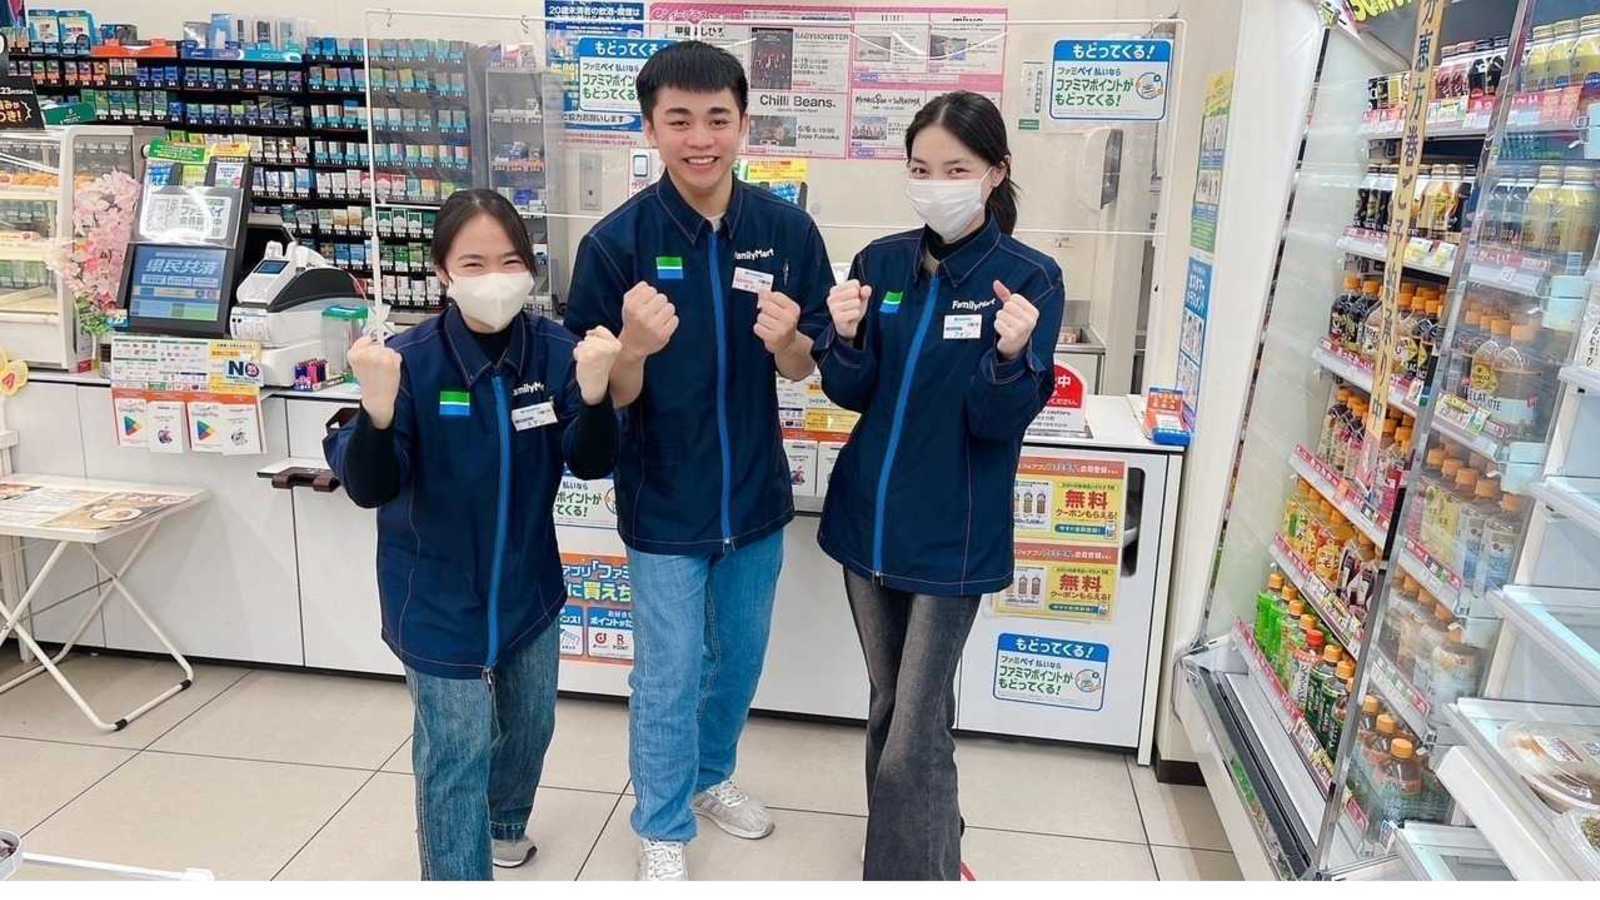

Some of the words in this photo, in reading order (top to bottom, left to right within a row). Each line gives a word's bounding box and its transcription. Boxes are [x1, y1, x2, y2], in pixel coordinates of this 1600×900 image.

[595, 41, 668, 56] もどってくる
[1073, 43, 1155, 59] もどってくる!
[1055, 78, 1133, 92] ファミマポイントが
[760, 94, 790, 107] Chilli
[793, 96, 836, 109] Beans.
[1055, 93, 1121, 107] もどってくる!
[952, 298, 996, 311] FamilyMart
[1065, 489, 1108, 510] 無料
[555, 503, 588, 518] てくる!
[1056, 508, 1118, 520] クーポンもらえる!
[1059, 574, 1103, 593] 無料
[1016, 636, 1095, 659] もどってくる!
[999, 665, 1073, 684] ファミマポイントが
[998, 676, 1062, 696] もどってくる!
